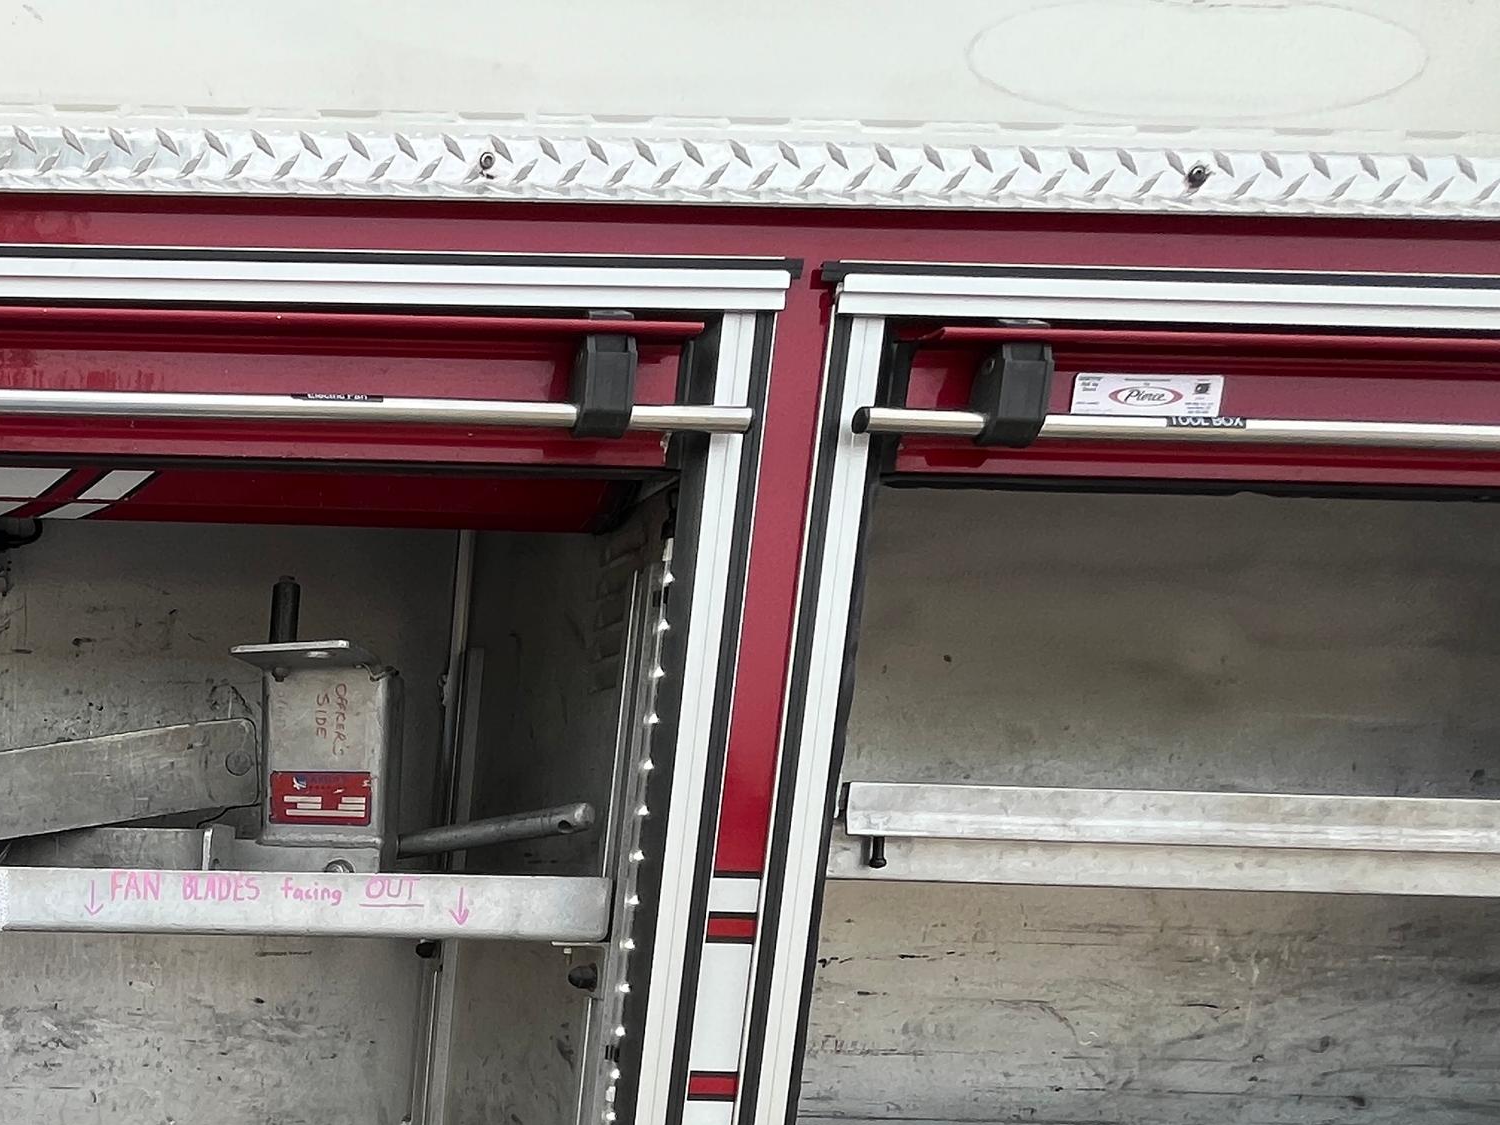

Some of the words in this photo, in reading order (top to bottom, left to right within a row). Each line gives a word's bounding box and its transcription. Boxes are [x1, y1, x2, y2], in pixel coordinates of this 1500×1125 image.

[1123, 388, 1166, 403] Pierce
[1171, 416, 1210, 426] TOOL
[315, 693, 330, 739] SIDE
[109, 869, 161, 901] FAN
[182, 874, 261, 902] BLADES
[280, 877, 343, 906] facing
[364, 875, 421, 901] OUT
